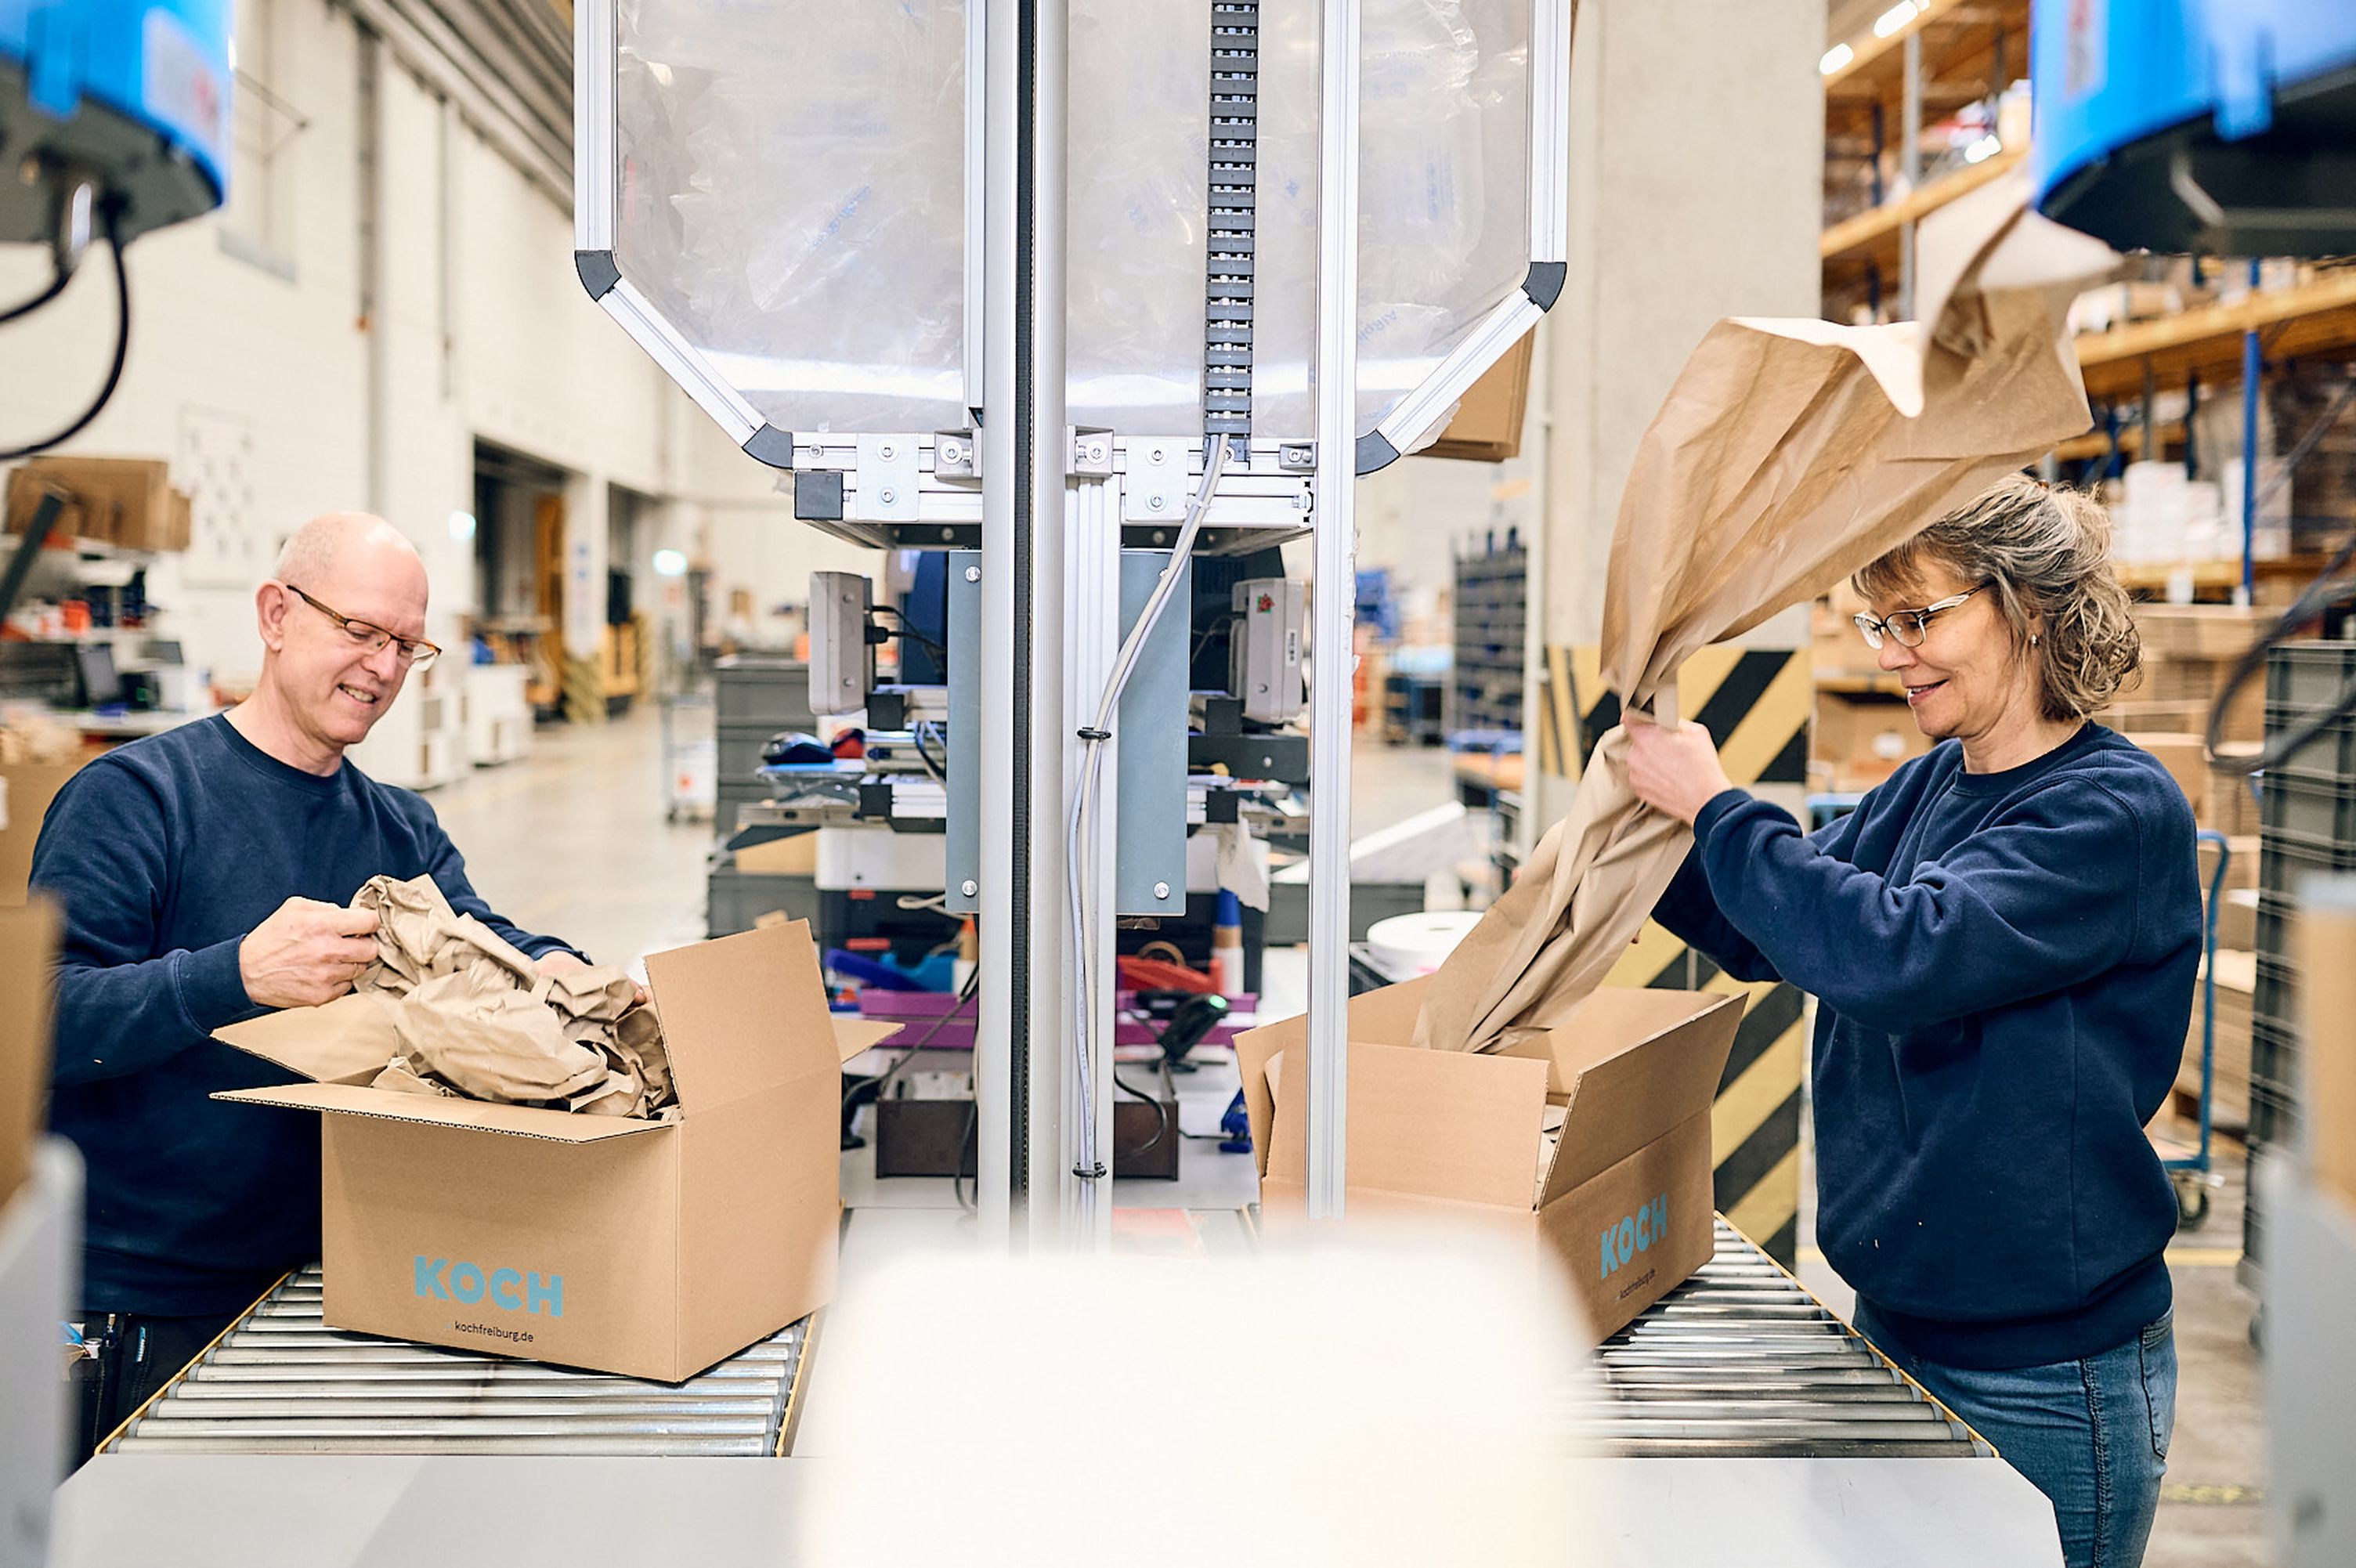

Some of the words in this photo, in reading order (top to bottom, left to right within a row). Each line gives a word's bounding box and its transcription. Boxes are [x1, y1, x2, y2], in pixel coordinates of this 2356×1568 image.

[1602, 1193, 1667, 1279] KOCH
[414, 1255, 562, 1317] KOCH
[454, 1321, 534, 1342] kochfreiburg.de
